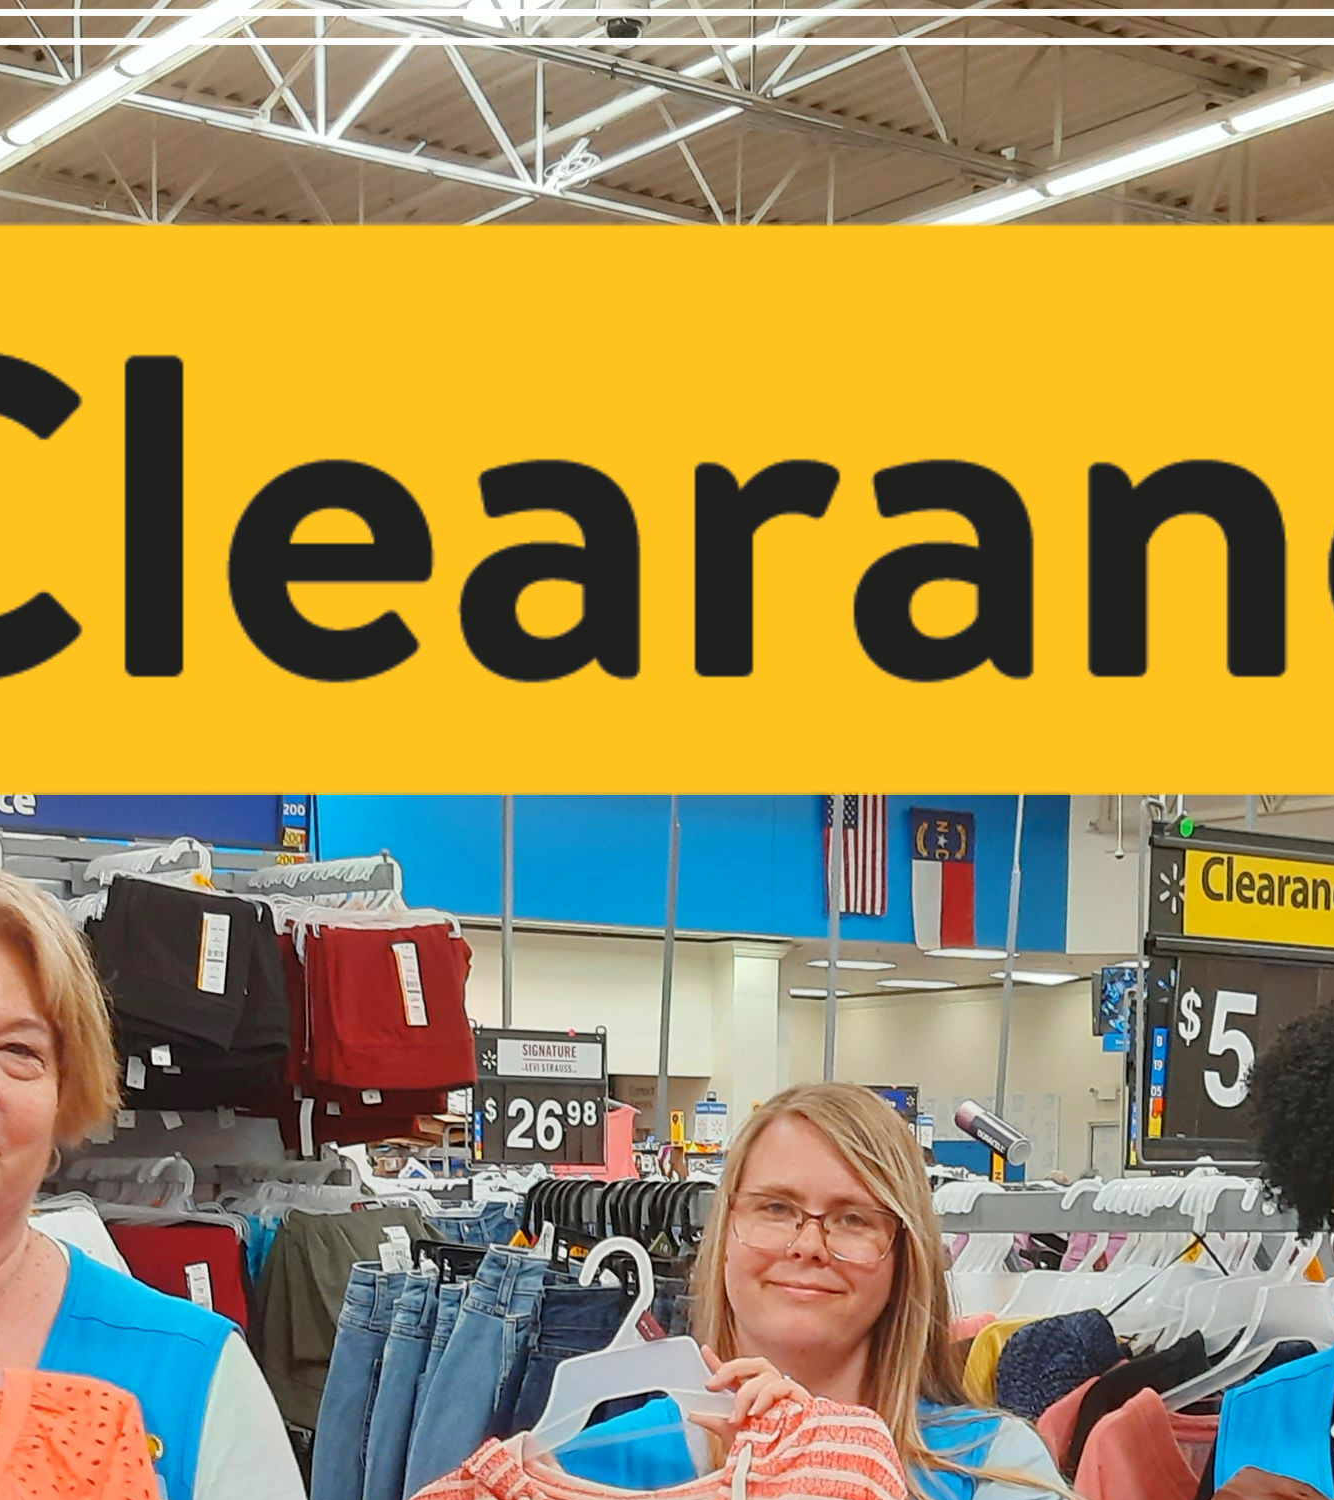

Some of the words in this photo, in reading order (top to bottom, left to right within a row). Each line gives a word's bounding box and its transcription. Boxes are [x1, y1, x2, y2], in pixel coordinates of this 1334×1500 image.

[282, 803, 306, 816] 200
[522, 1043, 578, 1059] SIGNATURE
[976, 1128, 1007, 1155] DURACELL
